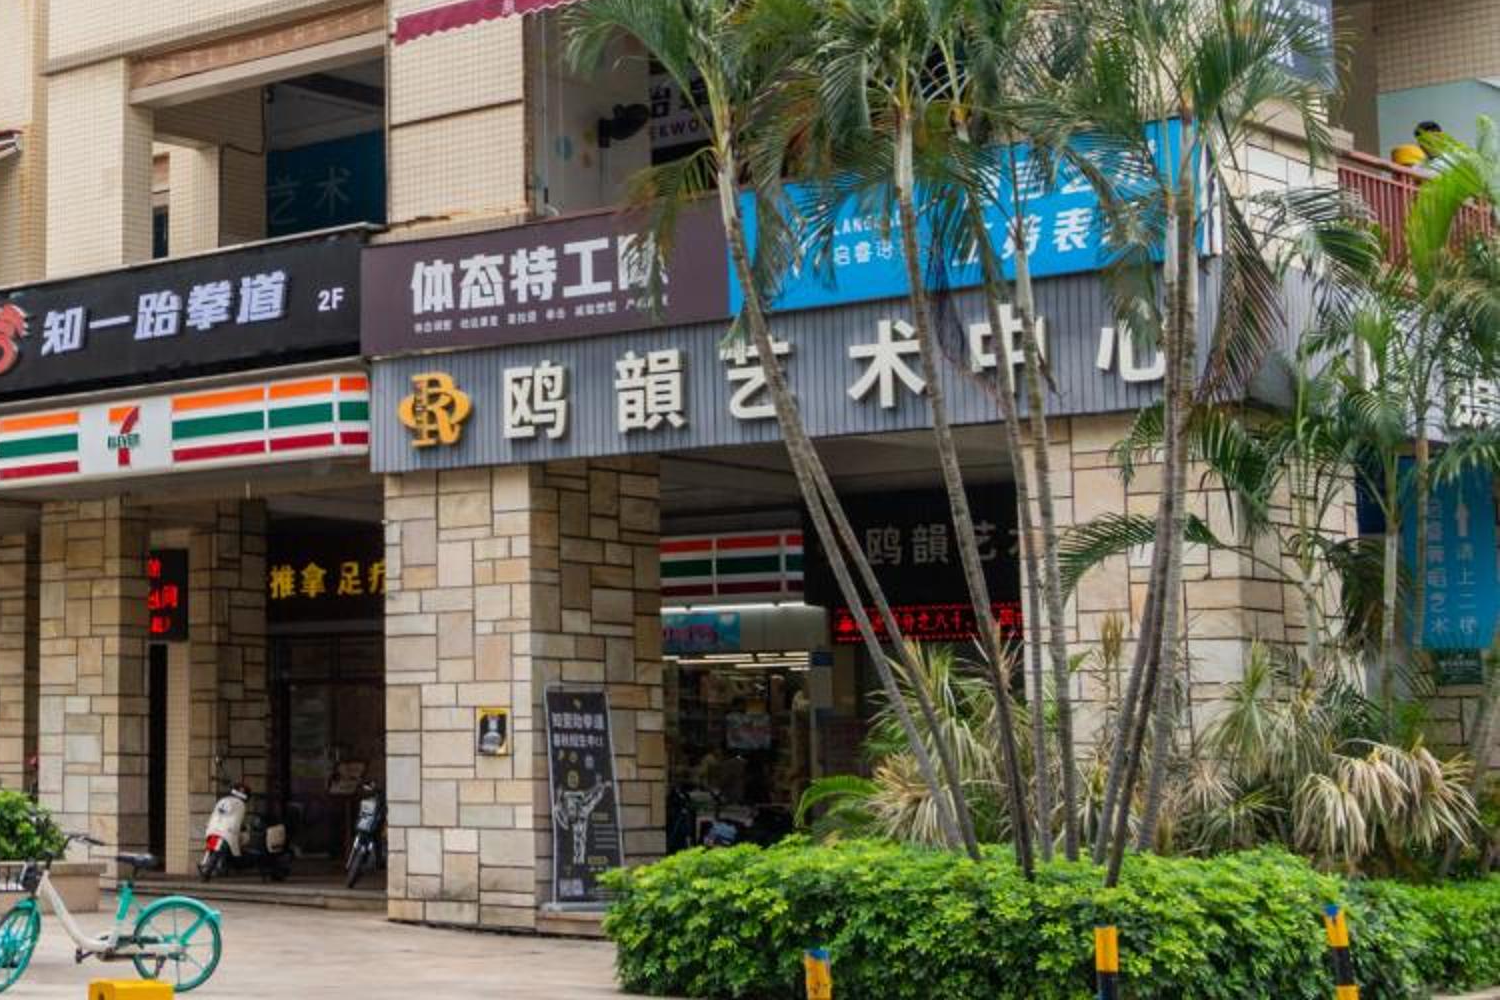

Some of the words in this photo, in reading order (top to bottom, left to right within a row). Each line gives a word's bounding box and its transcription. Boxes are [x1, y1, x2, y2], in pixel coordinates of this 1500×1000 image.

[41, 271, 285, 356] 知一跆拳道
[318, 287, 345, 312] 2F
[270, 563, 327, 599] 推拿
